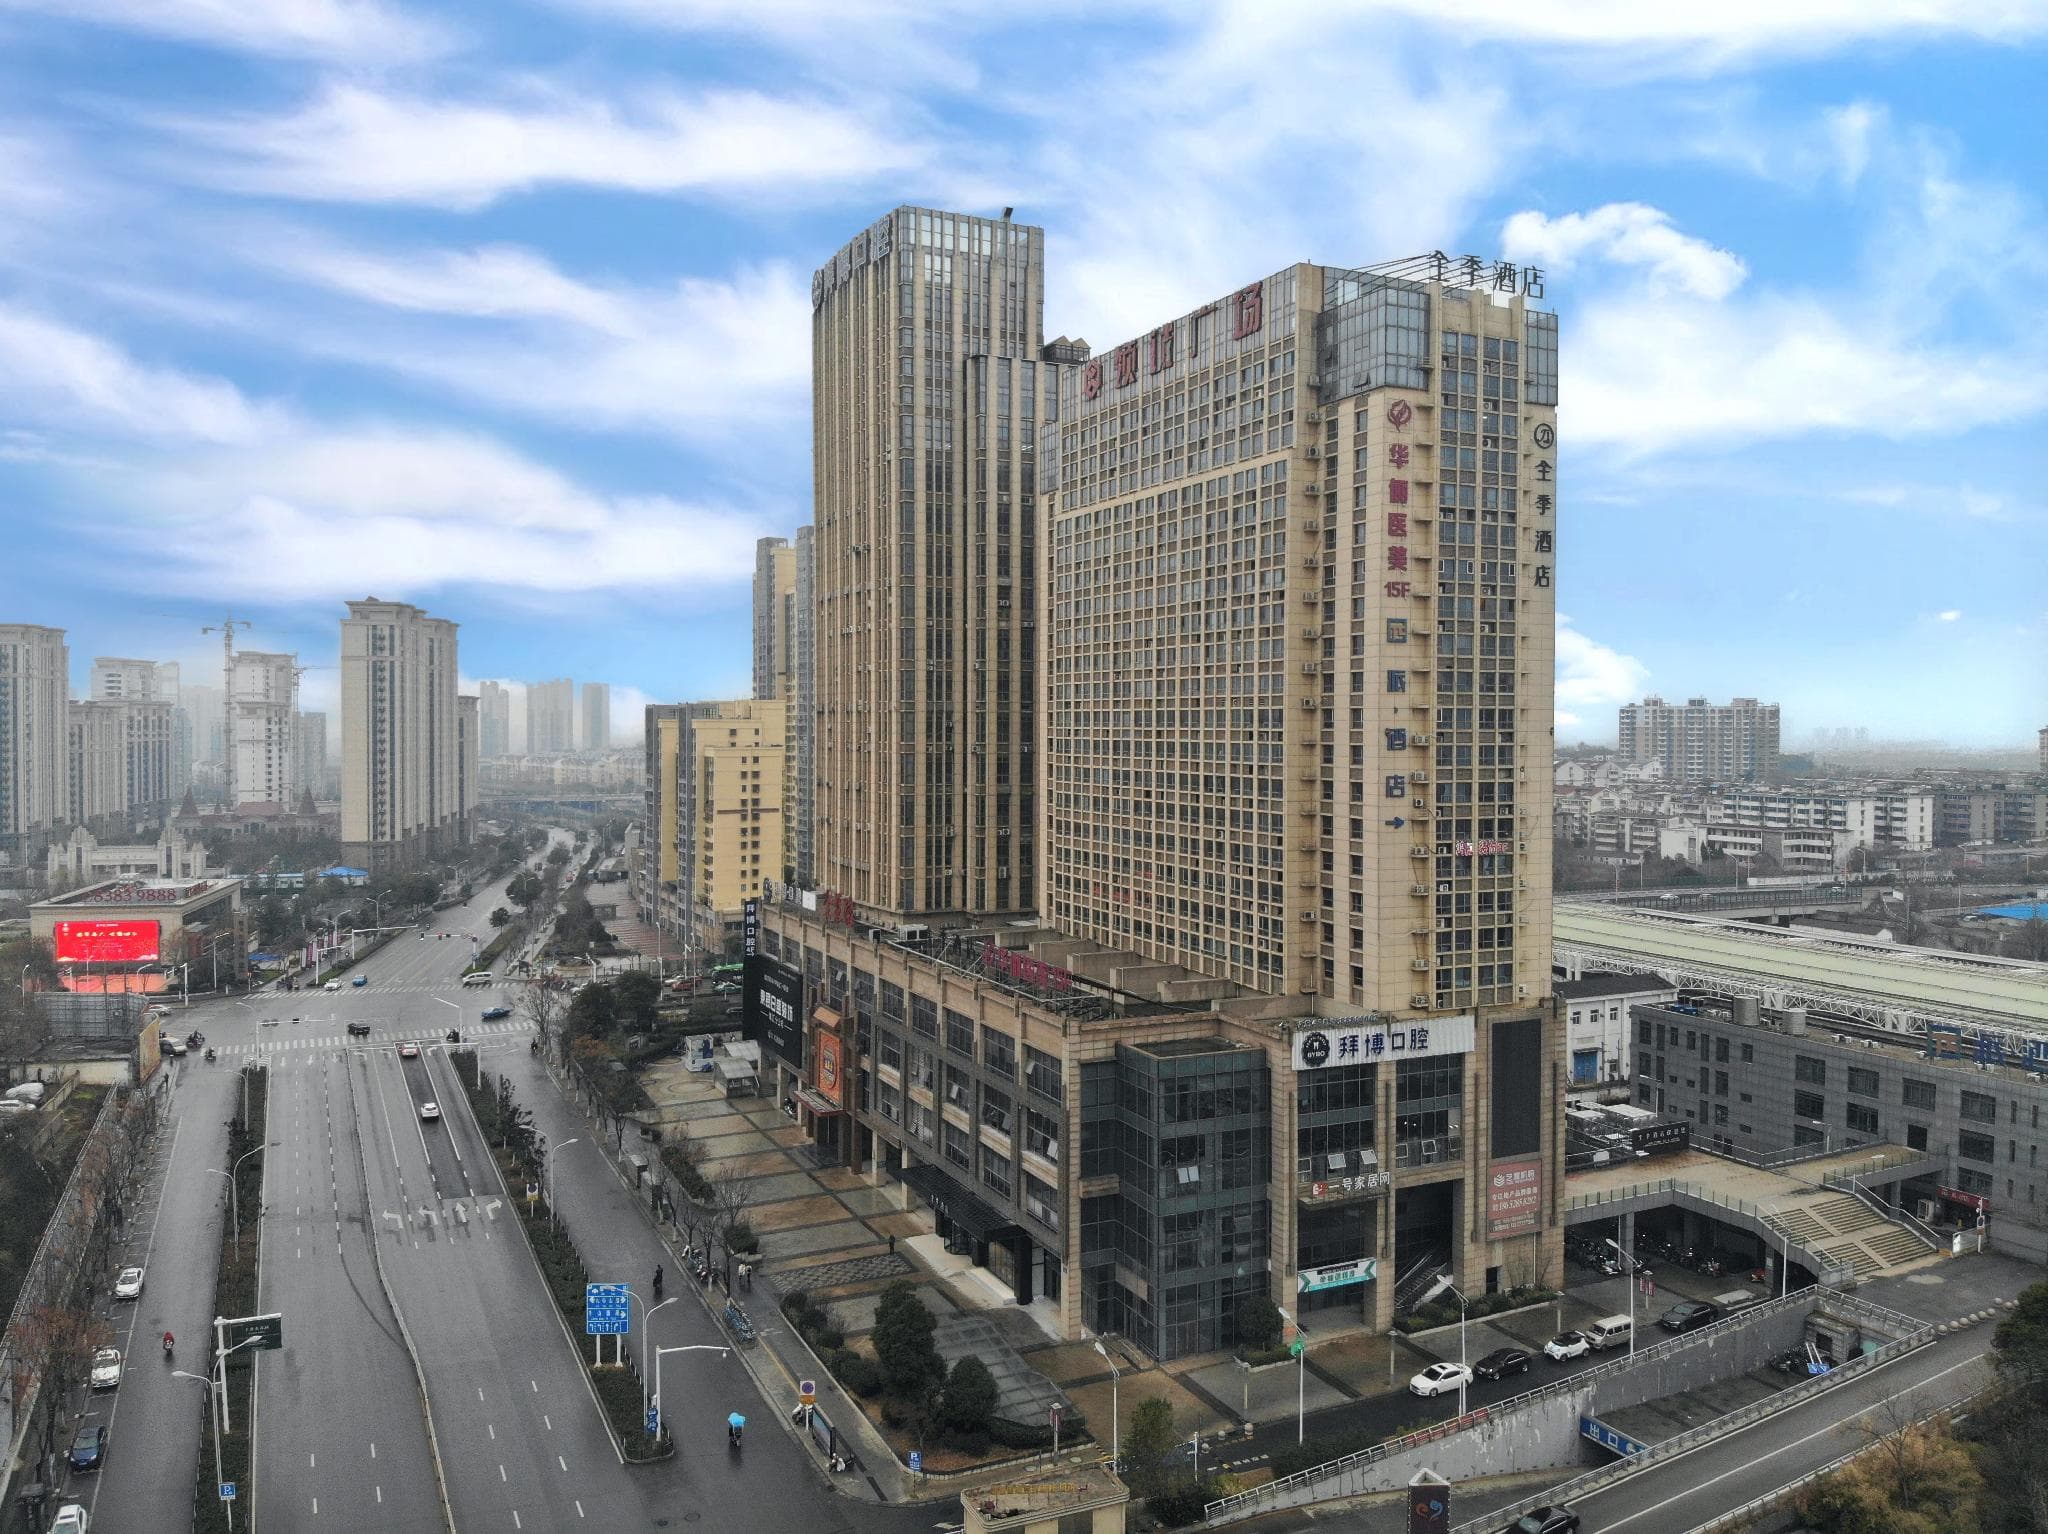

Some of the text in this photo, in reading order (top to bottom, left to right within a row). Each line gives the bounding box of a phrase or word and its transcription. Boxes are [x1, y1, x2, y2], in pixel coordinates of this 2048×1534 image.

[1428, 250, 1544, 299] 全季酒店
[1534, 459, 1552, 588] 全季酒店
[1384, 581, 1411, 598] 15F
[1338, 1027, 1429, 1058] 拜博口腔
[1328, 1171, 1390, 1192] 一号家居网
[1590, 1423, 1618, 1448] 出口
